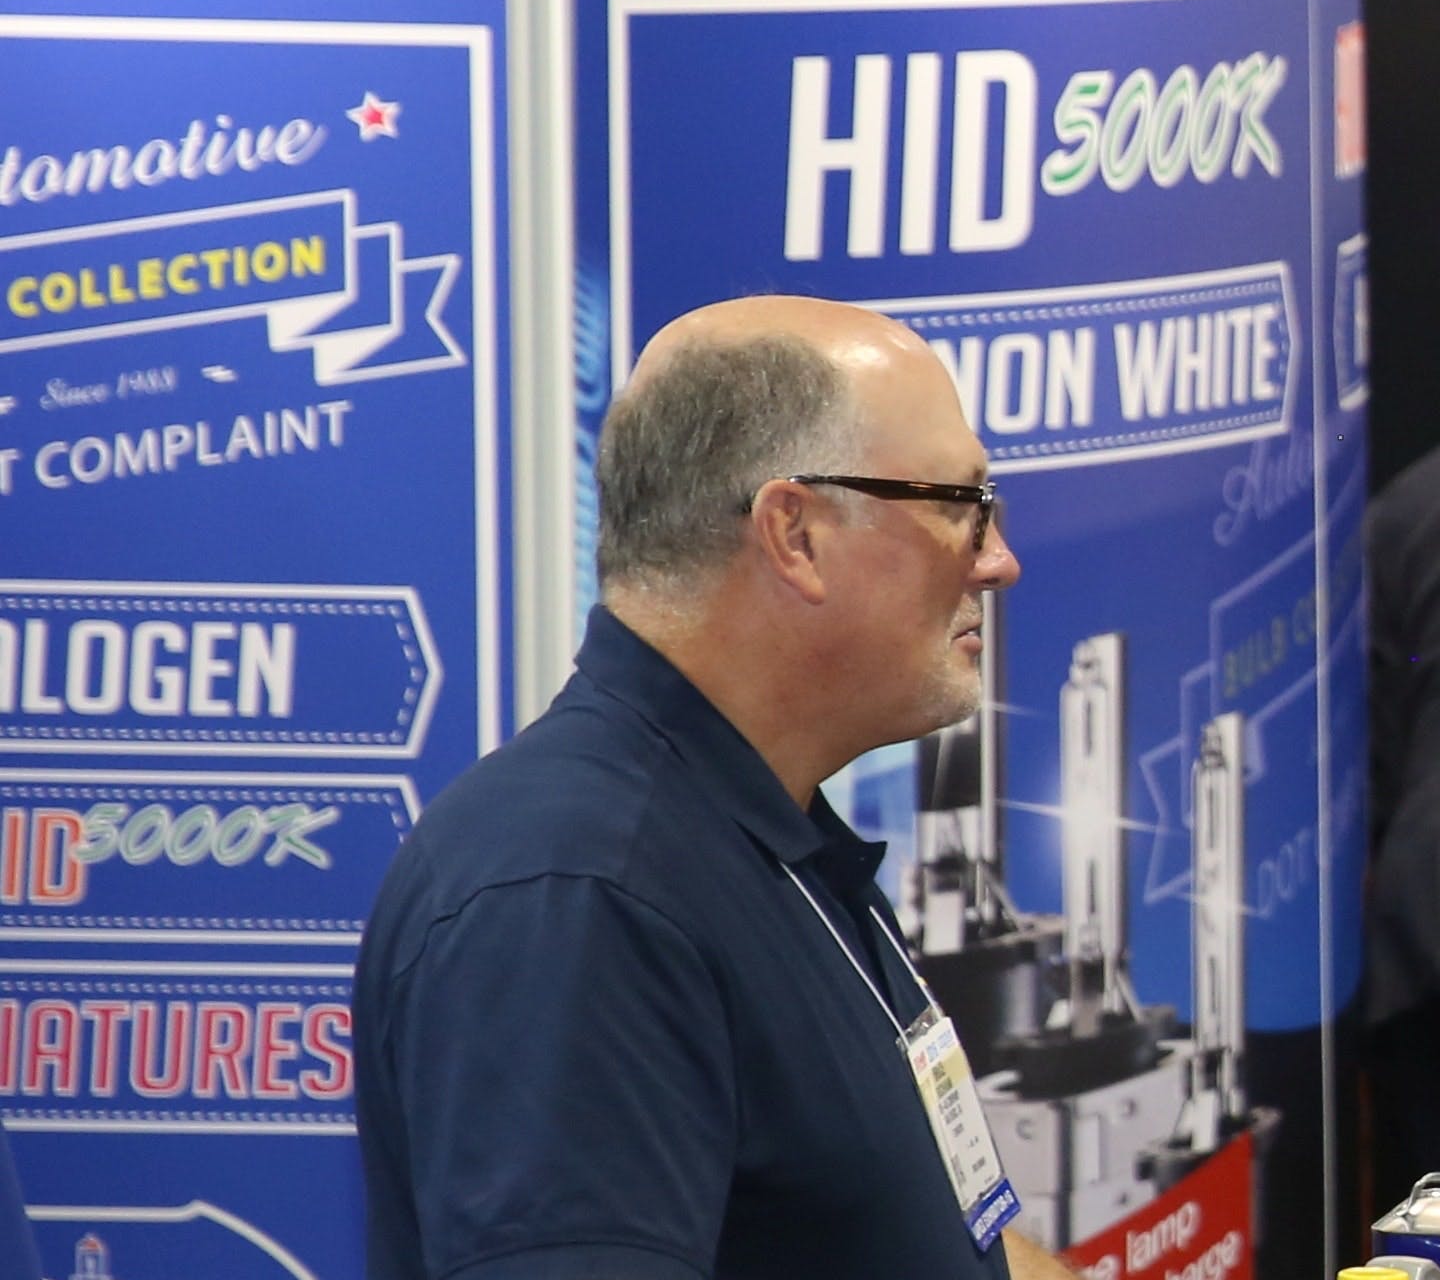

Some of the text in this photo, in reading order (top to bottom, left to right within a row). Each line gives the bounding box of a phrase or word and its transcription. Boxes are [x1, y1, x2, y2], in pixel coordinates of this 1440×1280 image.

[783, 49, 1287, 263] HID 5000K
[6, 235, 326, 319] COLLECTION
[40, 376, 114, 410] Since
[1113, 299, 1282, 423] WHITE
[34, 399, 353, 490] COMPLAINT
[74, 802, 343, 871] 5000K
[1124, 1199, 1203, 1276] lamp
